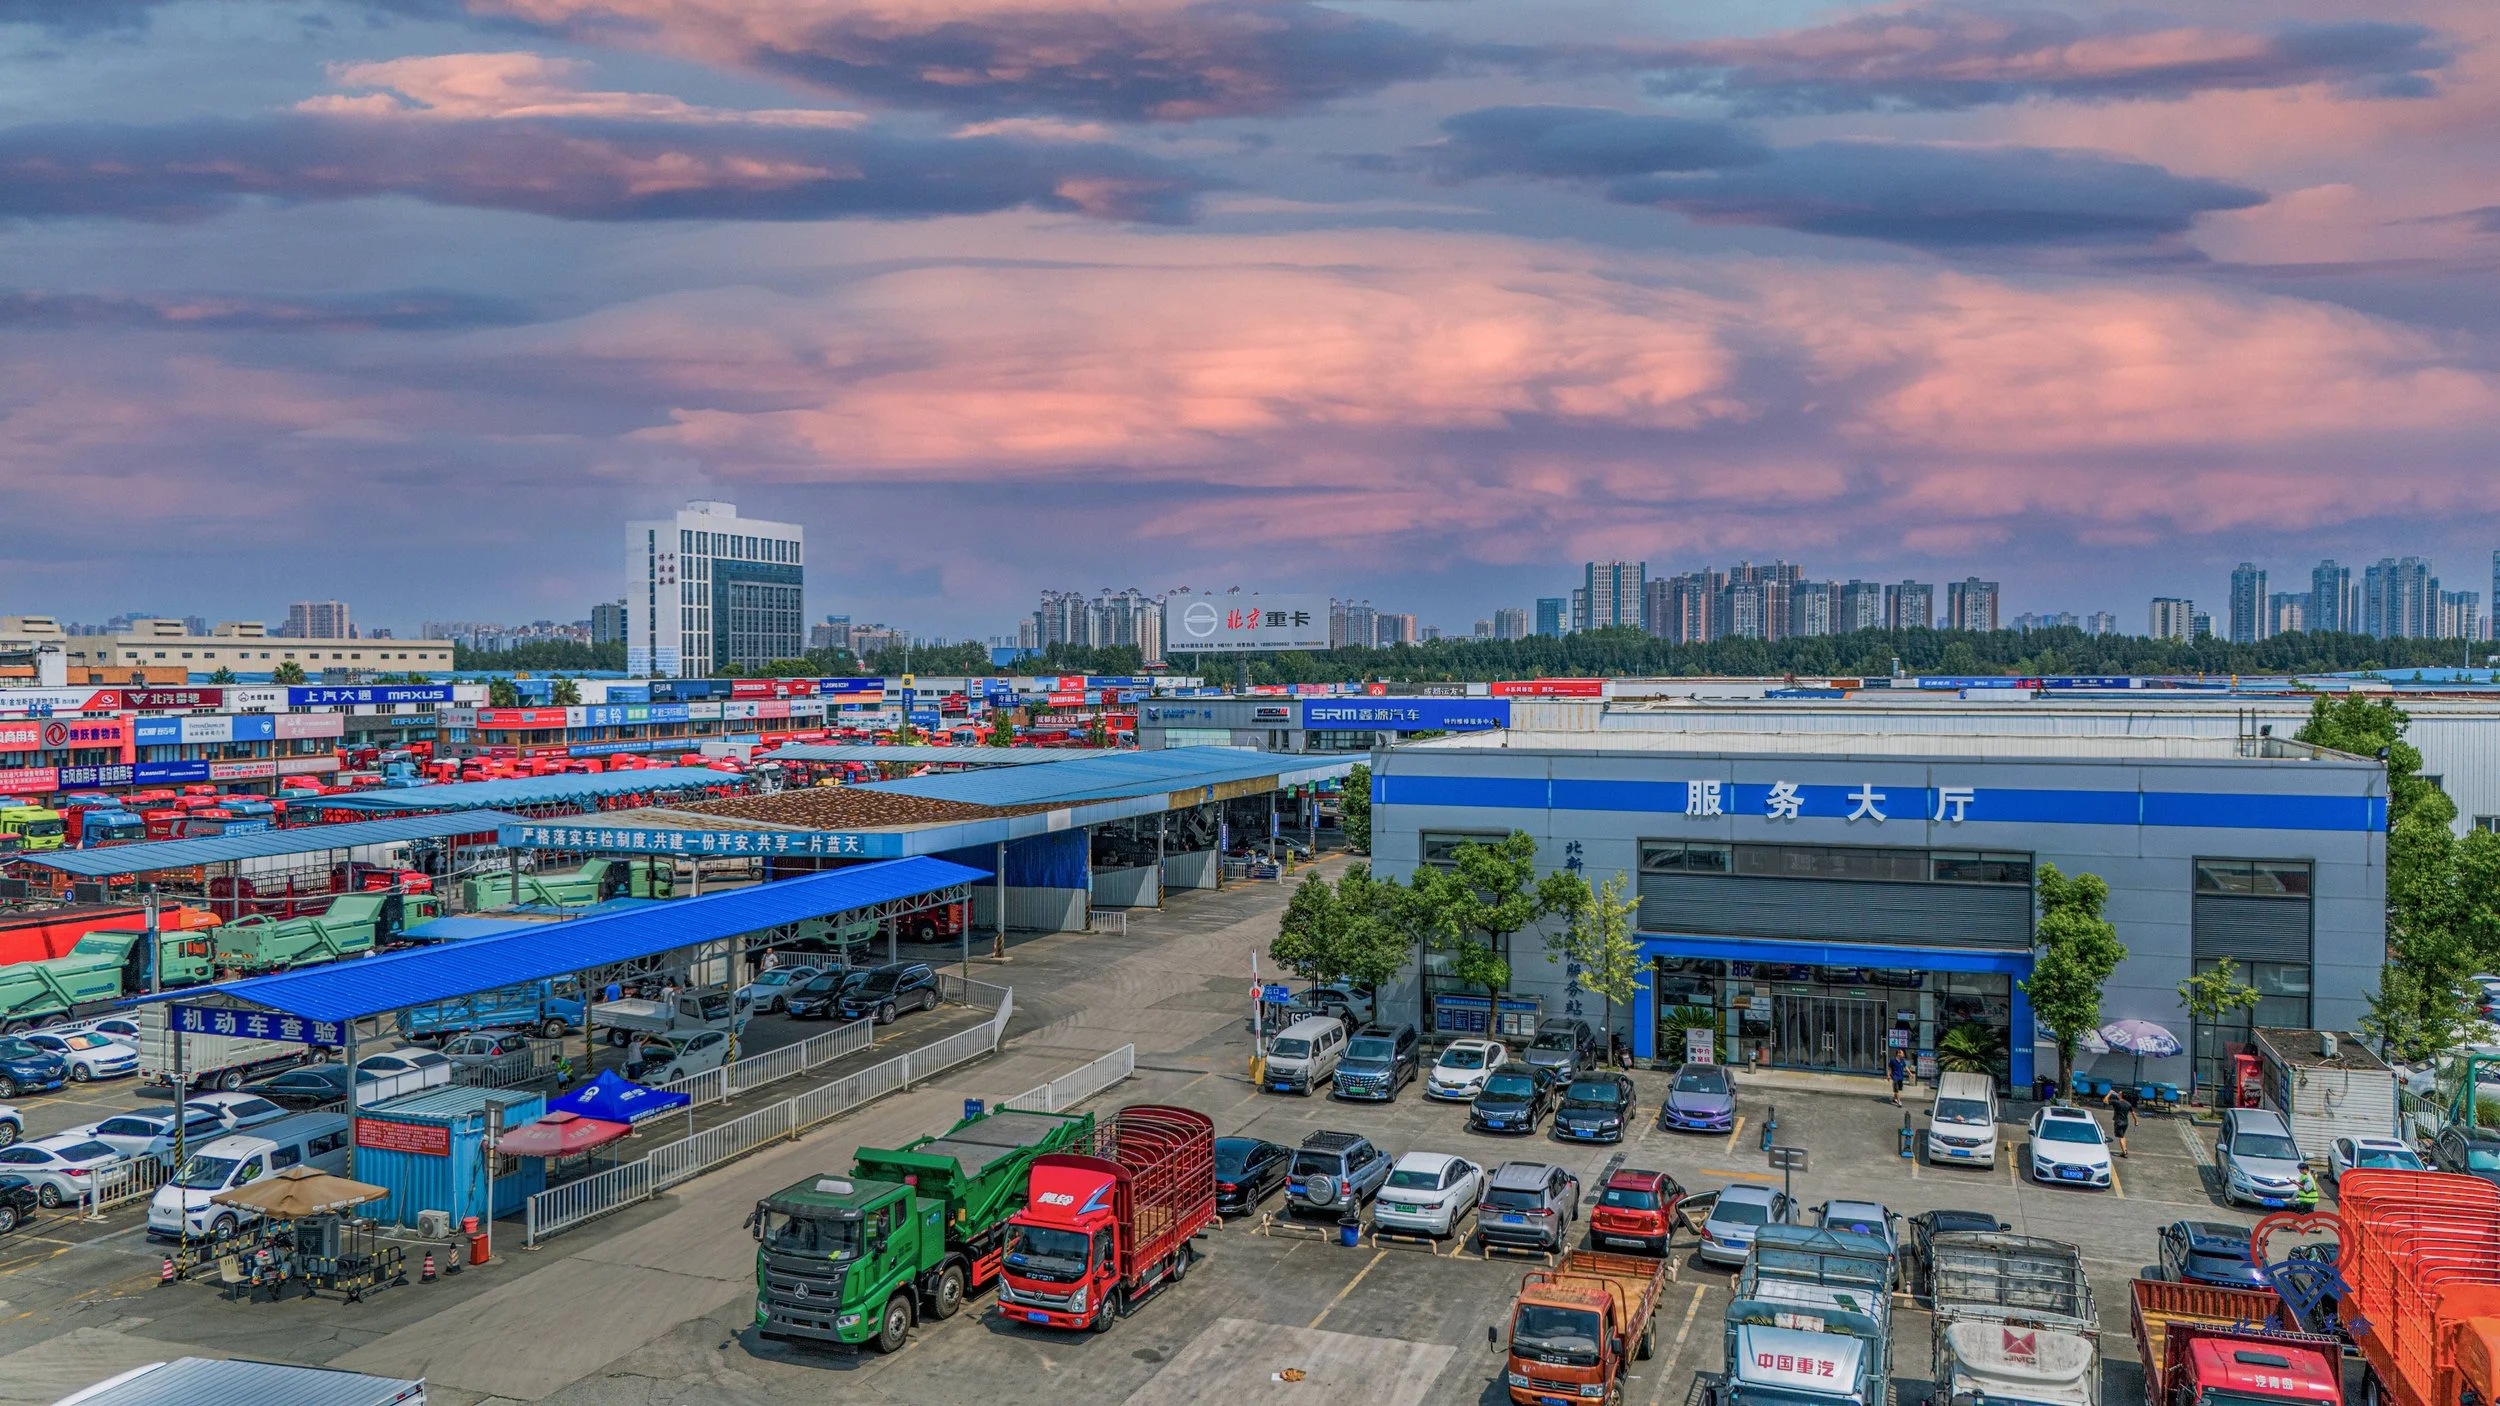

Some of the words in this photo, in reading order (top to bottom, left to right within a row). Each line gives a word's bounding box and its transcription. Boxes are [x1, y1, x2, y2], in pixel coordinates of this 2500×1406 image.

[1227, 607, 1311, 630] 北京重卡
[305, 690, 372, 702] 上汽大通
[388, 690, 444, 700] MAXUS
[391, 717, 437, 726] MAXUS
[595, 708, 623, 725] 奥铃
[1311, 708, 1357, 720] SRM
[1358, 708, 1421, 721] 鑫源汽车
[61, 769, 98, 784] 东风商用车
[98, 766, 134, 781] 解放商用车
[1685, 780, 1975, 823] 服务大厅
[182, 1008, 339, 1043] 机动车查验
[1026, 1272, 1055, 1282] FOTON
[1540, 1354, 1569, 1364] DFAC
[1757, 1352, 1835, 1378] 中国重汽
[2005, 1356, 2036, 1364] JMC
